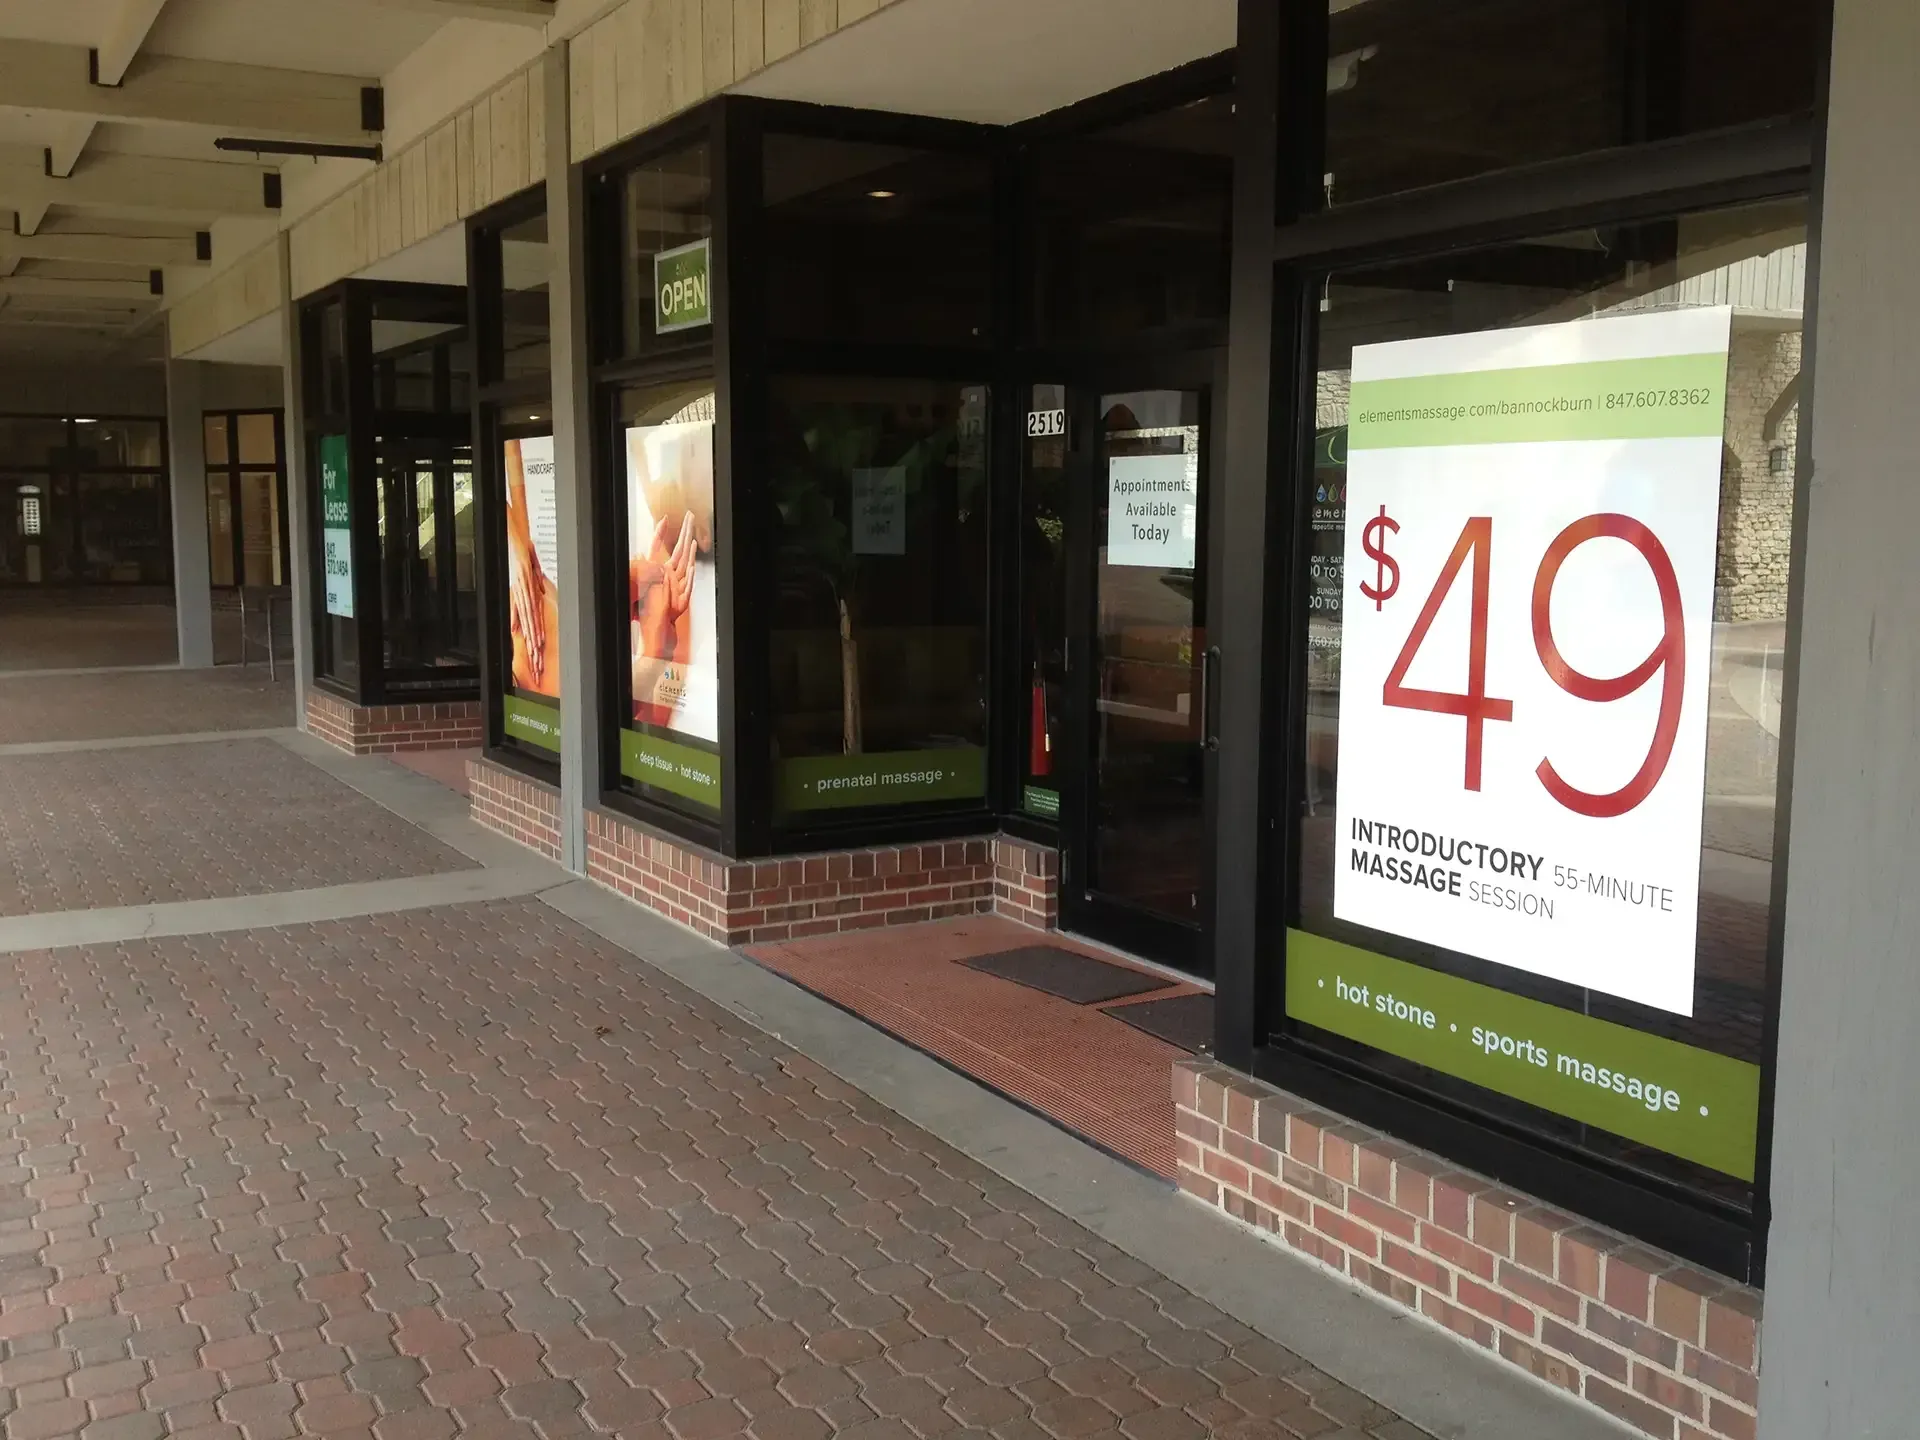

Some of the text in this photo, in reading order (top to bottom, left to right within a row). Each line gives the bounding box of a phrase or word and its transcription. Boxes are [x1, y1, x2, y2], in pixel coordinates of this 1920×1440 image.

[661, 273, 706, 316] OPEN
[1359, 395, 1592, 424] elementsmassage.com/bannockburn
[1605, 387, 1711, 410] 847.607.8362
[1029, 411, 1064, 435] 2519
[323, 463, 337, 491] For
[1113, 479, 1191, 496] Appointments
[324, 494, 348, 522] Lease
[1126, 502, 1177, 517] Available
[1132, 523, 1170, 545] Today
[1323, 566, 1337, 578] TO
[1316, 587, 1342, 596] SUNDAY
[1325, 598, 1339, 610] TO
[1359, 504, 1686, 818] $49
[640, 751, 711, 786] deep tissue hot stone
[817, 769, 943, 793] prenatal massage
[1351, 817, 1673, 913] INTRODUCTORY 55-MINUTE
[1350, 848, 1555, 920] MASSAGE SESSION
[1335, 975, 1681, 1113] hot stone sports massage
